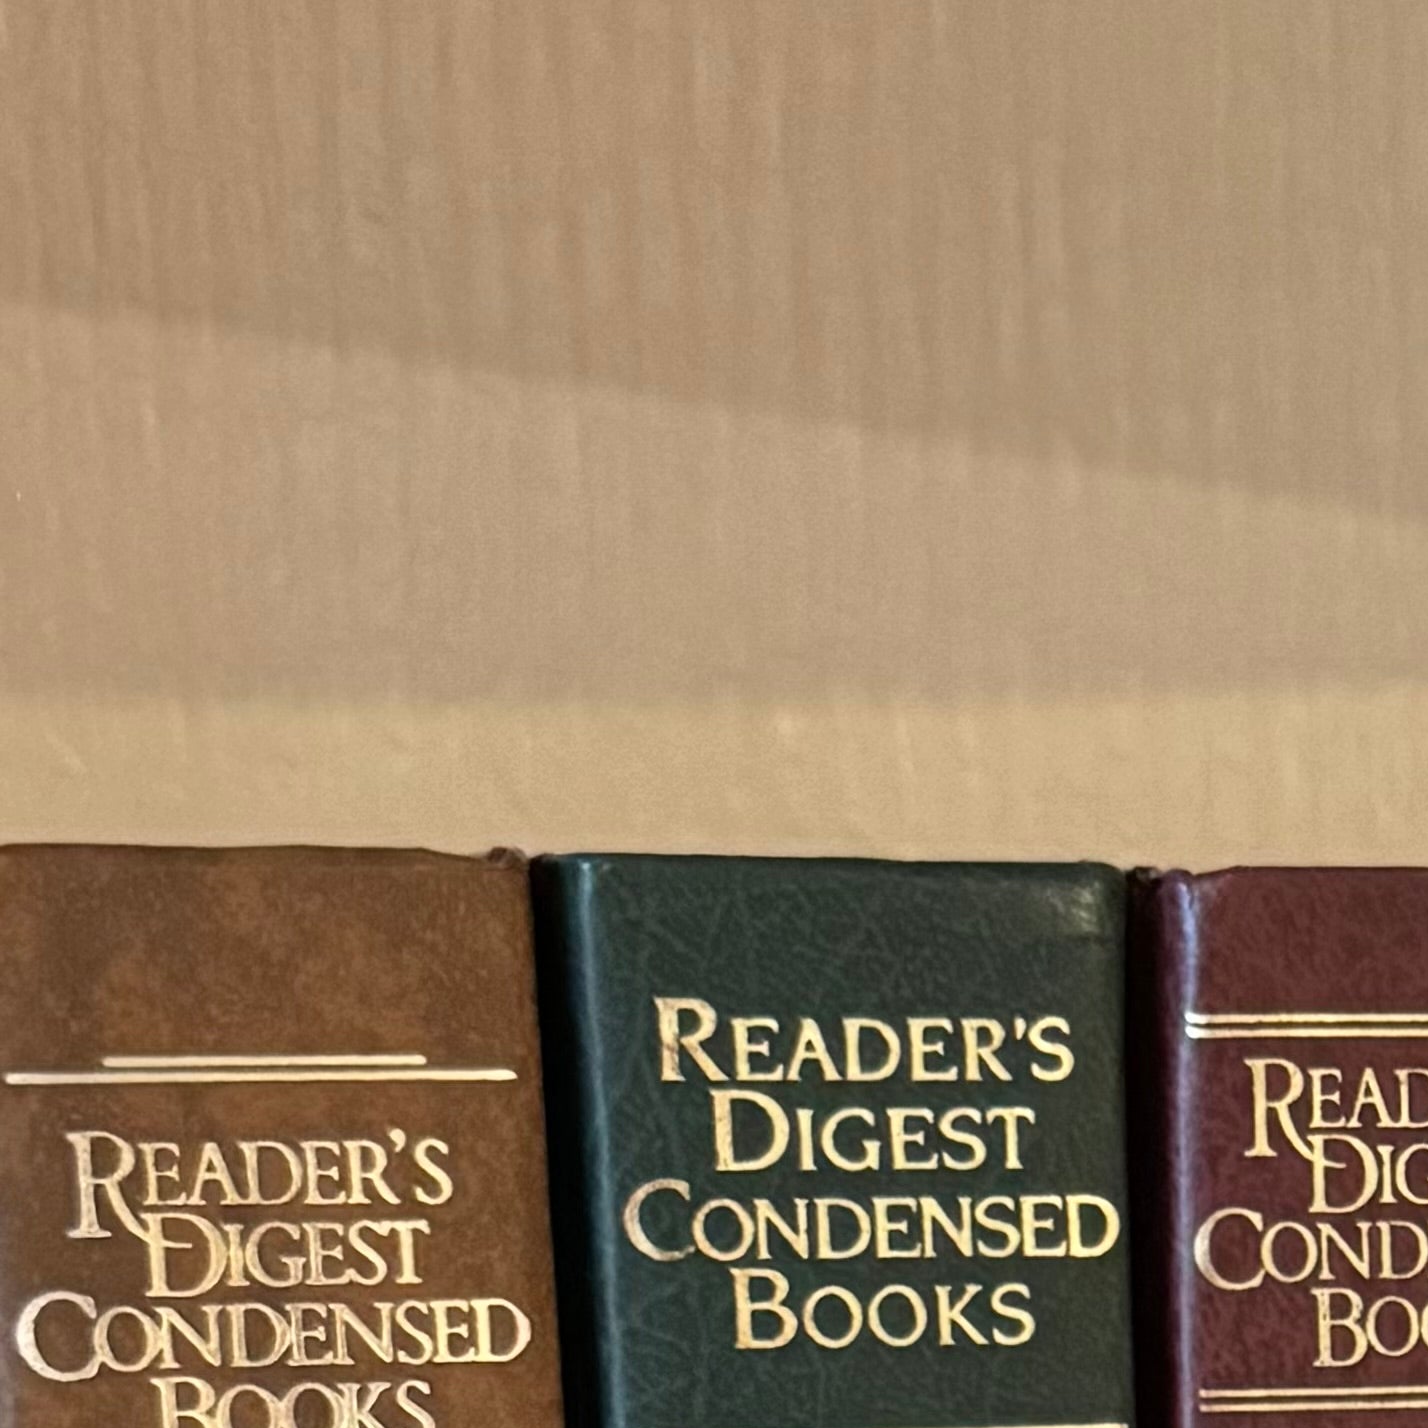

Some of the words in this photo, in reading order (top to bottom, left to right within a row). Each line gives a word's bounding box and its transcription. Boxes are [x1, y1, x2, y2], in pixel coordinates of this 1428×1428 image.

[653, 997, 1075, 1083] READER'S
[709, 1089, 1036, 1172] DIGEST
[66, 1129, 453, 1241] READER'S
[623, 1178, 1120, 1262] CONDENSED
[143, 1213, 430, 1298] DIGEST
[15, 1291, 532, 1382] CONDENSED
[729, 1267, 1036, 1349] BOOKS
